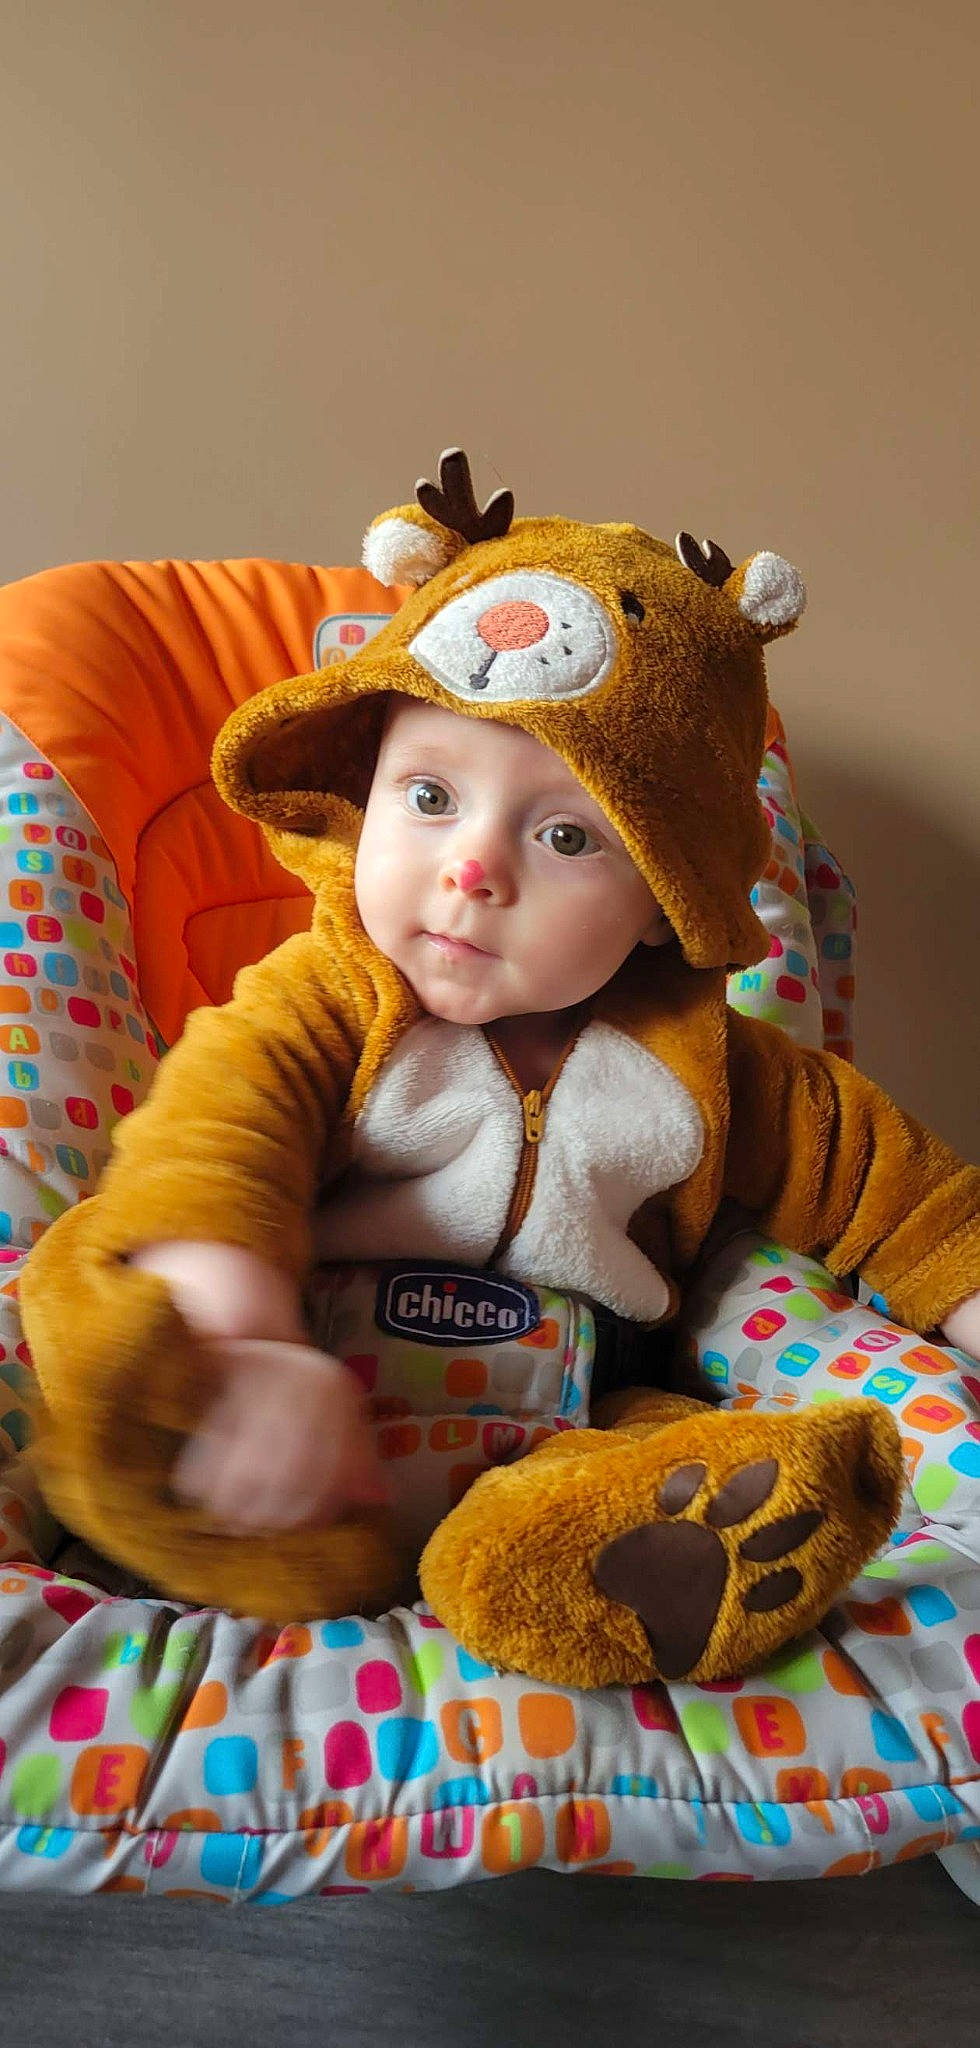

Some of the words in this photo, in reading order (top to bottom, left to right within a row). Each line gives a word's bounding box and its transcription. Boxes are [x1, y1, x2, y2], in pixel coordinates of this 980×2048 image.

[26, 851, 43, 872] S
[740, 973, 762, 992] M
[9, 1026, 30, 1053] A
[13, 1062, 32, 1088] b
[397, 1281, 519, 1330] chicco
[871, 1375, 906, 1396] S
[754, 1702, 785, 1751] E
[282, 1739, 305, 1791] F
[93, 1753, 127, 1809] E
